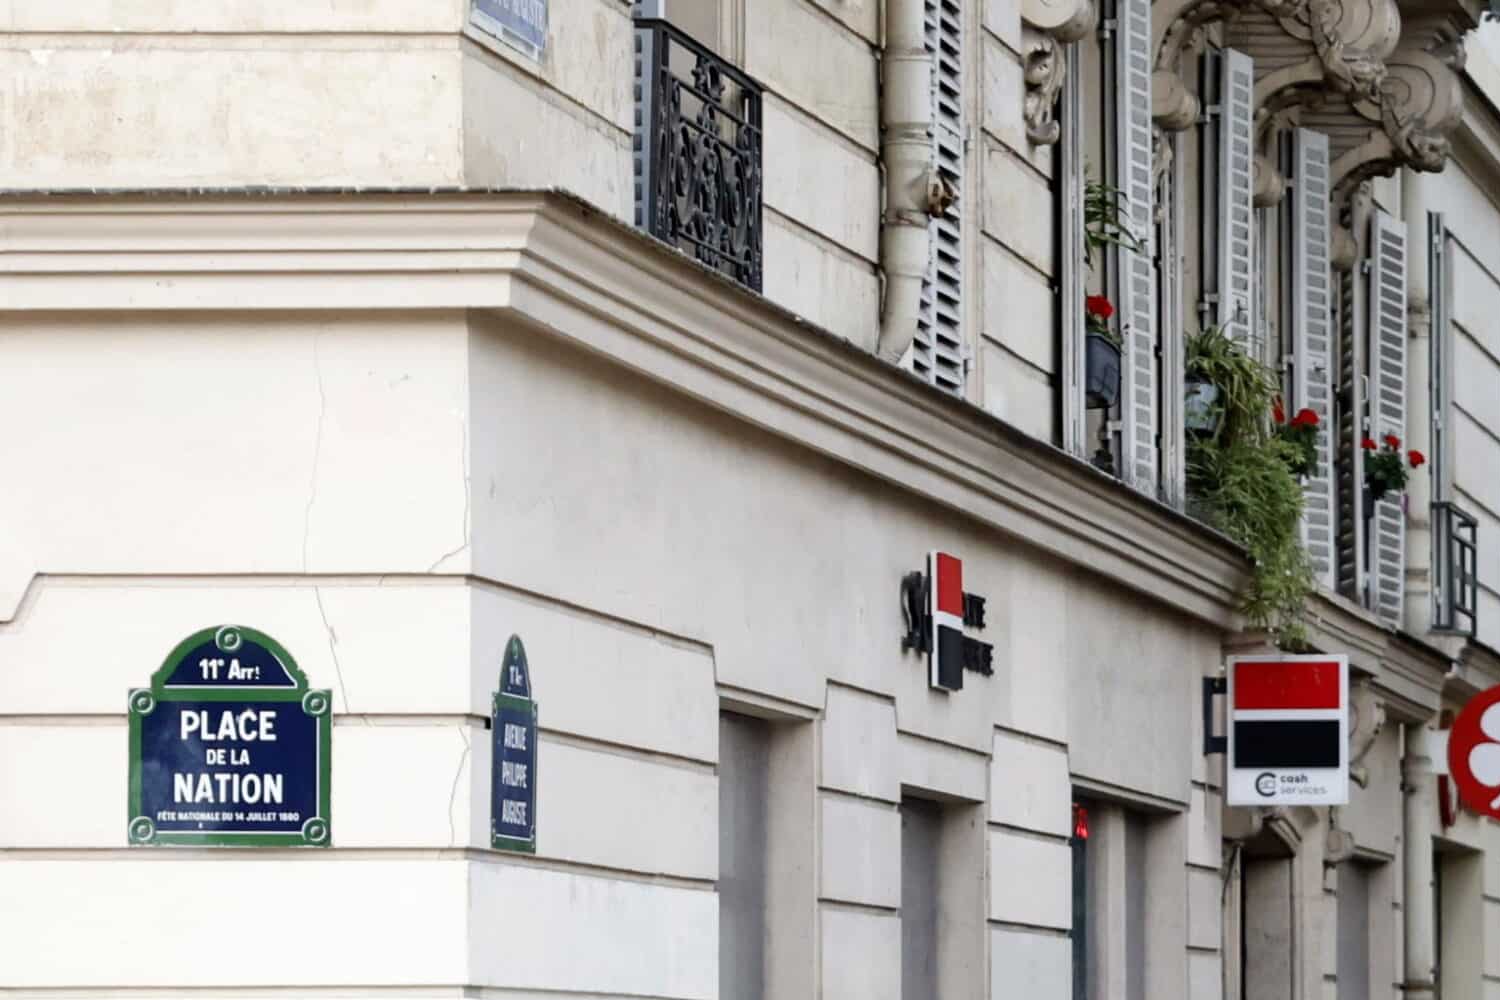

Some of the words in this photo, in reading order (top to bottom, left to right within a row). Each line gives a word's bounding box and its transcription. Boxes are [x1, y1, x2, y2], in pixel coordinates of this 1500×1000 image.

[180, 709, 277, 741] PLACE
[206, 750, 226, 765] DE
[230, 750, 250, 765] LA
[1280, 774, 1308, 784] cash
[173, 773, 284, 803] NATION
[157, 810, 177, 821] FÊTE
[177, 811, 220, 821] NATIONALE
[222, 811, 233, 821] DU
[235, 812, 244, 821] 14
[246, 812, 276, 822] JUILLET
